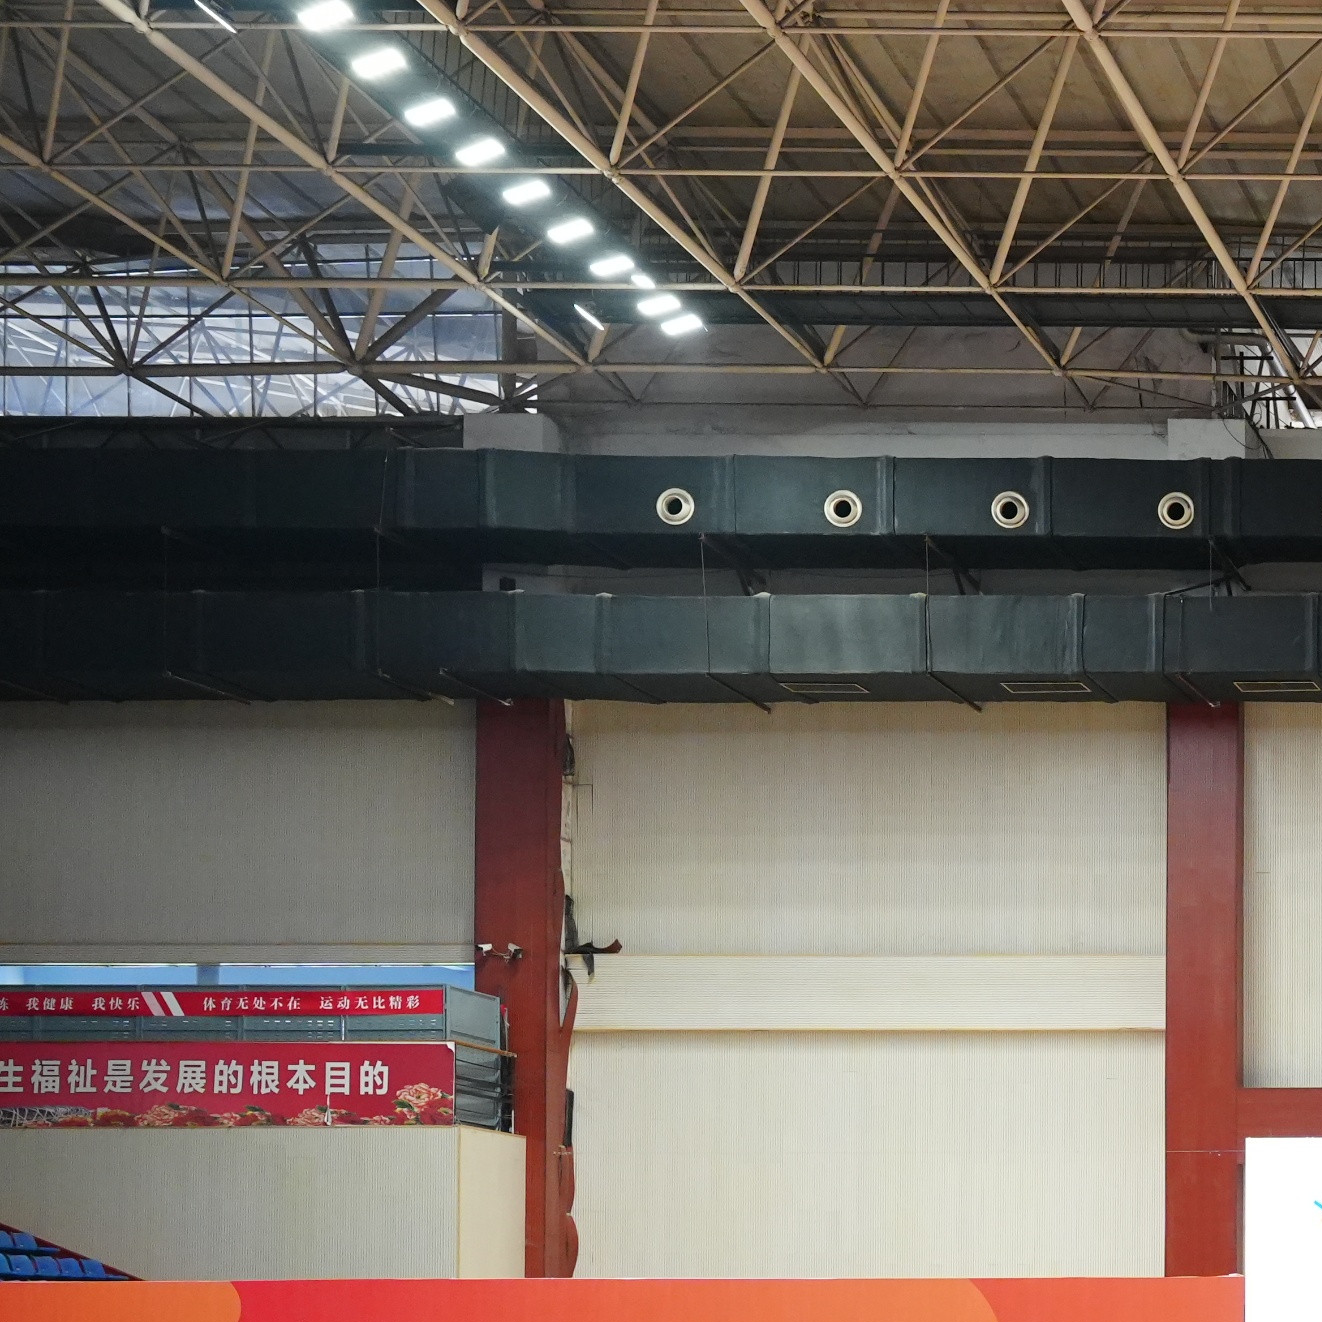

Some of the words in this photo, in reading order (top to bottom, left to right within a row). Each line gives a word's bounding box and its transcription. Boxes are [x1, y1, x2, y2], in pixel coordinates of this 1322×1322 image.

[26, 997, 73, 1011] 我健康
[92, 997, 140, 1011] 我快乐
[203, 996, 300, 1011] 体育无处不在
[319, 995, 420, 1010] 运动无比精彩
[0, 1059, 389, 1095] 生福祉是发展的根本目的
